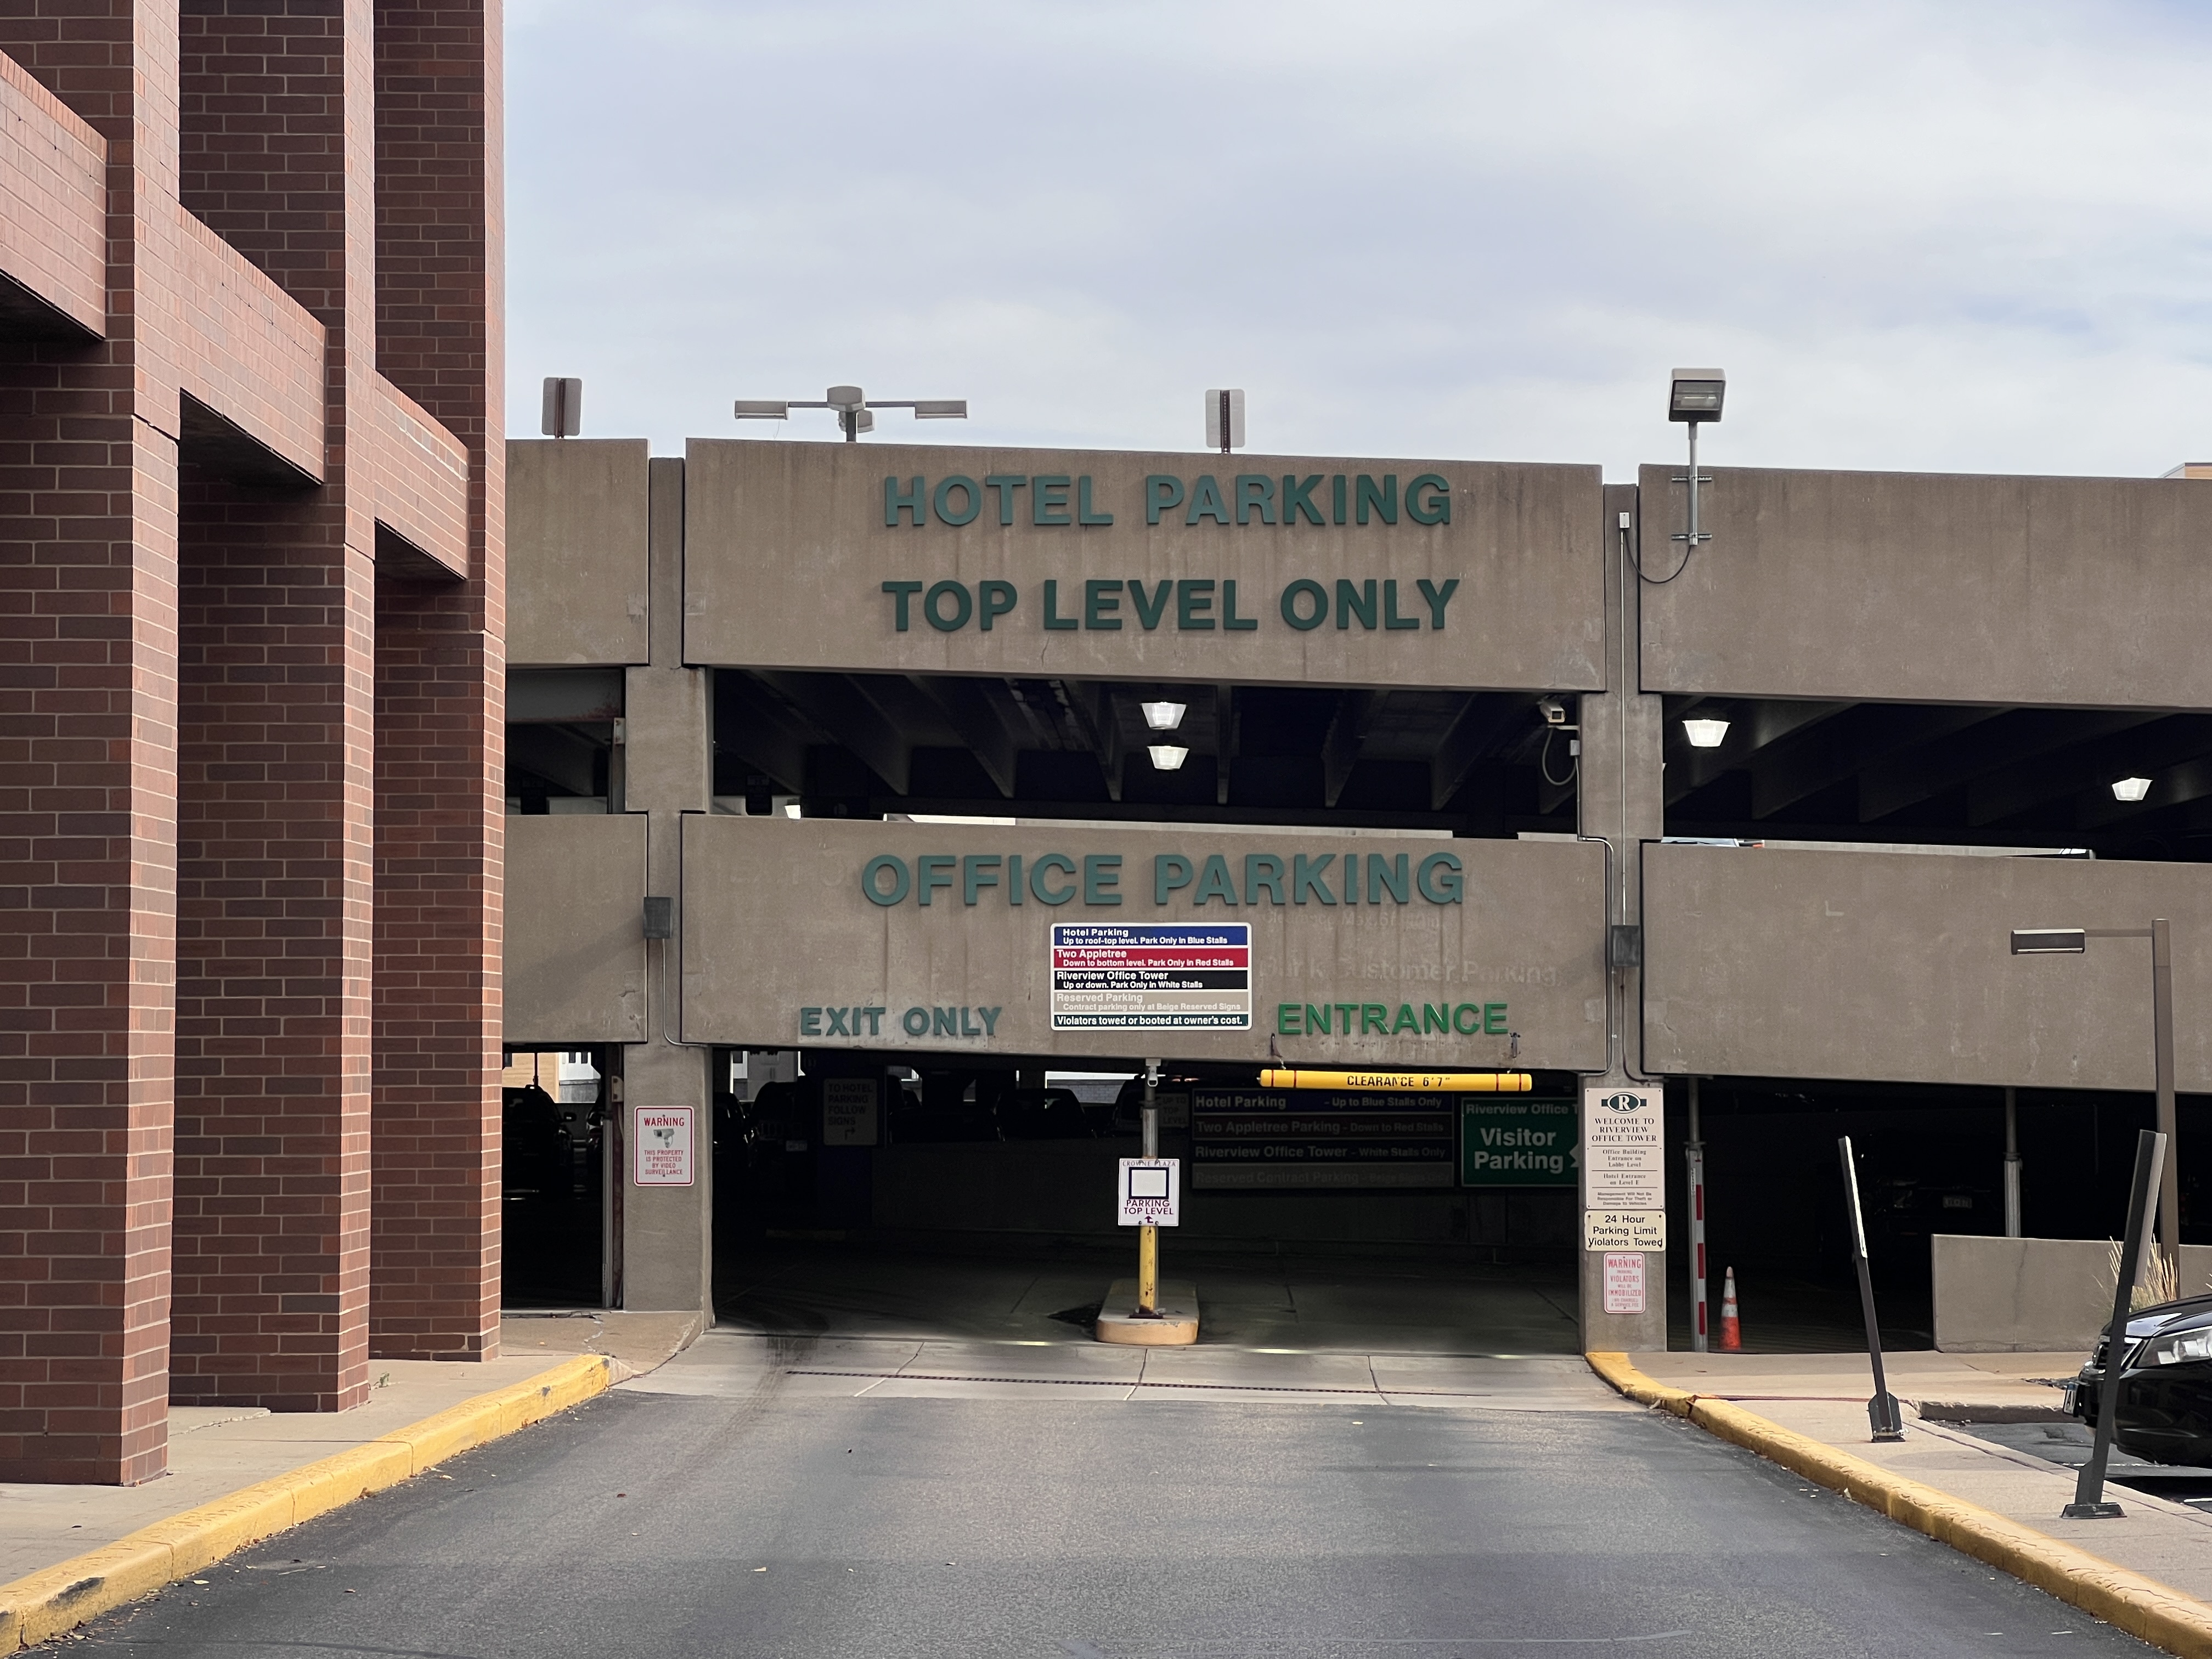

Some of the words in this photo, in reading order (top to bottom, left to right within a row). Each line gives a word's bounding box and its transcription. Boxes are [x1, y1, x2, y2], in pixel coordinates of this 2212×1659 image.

[886, 476, 1113, 525] HOTEL
[1148, 474, 1450, 525] PARKING
[883, 580, 1017, 631] TOP
[1045, 579, 1257, 630] LEVEL
[1282, 579, 1457, 630] ONLY
[865, 854, 1121, 905] OFFICE
[1157, 852, 1462, 902] PARKING
[1091, 929, 1128, 938] Parking
[1063, 937, 1074, 945] Up
[1085, 937, 1117, 945] roof-top
[1159, 937, 1177, 945] Only
[1080, 950, 1127, 960] Appletree
[1167, 960, 1185, 968] Only
[1057, 972, 1104, 980] Riverview
[1107, 972, 1136, 980] Office
[1139, 972, 1169, 980] Tower
[1063, 981, 1074, 990] Up
[1130, 981, 1148, 990] Only
[1057, 994, 1103, 1002] Reserved
[1106, 994, 1143, 1003] Parking
[1098, 1004, 1128, 1012] parking
[1129, 1003, 1145, 1012] only
[1156, 1003, 1179, 1012] Beige
[1219, 1003, 1240, 1012] Signs
[800, 1007, 886, 1036] EXIT
[903, 1007, 1002, 1036] ONLY
[1057, 1016, 1097, 1025] Violators
[1099, 1016, 1126, 1025] towed
[1139, 1016, 1171, 1025] booted
[1184, 1015, 1218, 1024] owner's
[1220, 1016, 1242, 1024] cost.
[1277, 1002, 1508, 1036] ENTRANCE
[1347, 1076, 1414, 1088] CLEARANCE
[1195, 1096, 1231, 1107] Hotel
[1235, 1096, 1286, 1109] Parking
[1332, 1097, 1347, 1108] Up
[1349, 1097, 1359, 1107] to
[1362, 1097, 1385, 1107] Blue
[1387, 1097, 1415, 1107] Stalls
[1418, 1097, 1442, 1109] Only
[1618, 1096, 1630, 1110] R
[1466, 1104, 1527, 1115] Riverview
[1531, 1104, 1567, 1114] Office
[644, 1118, 684, 1126] WARNING
[1198, 1121, 1222, 1132] Two
[1226, 1121, 1288, 1135] Appletree
[1291, 1121, 1340, 1135] Parking
[1381, 1124, 1392, 1132] to
[1481, 1127, 1556, 1147] Visitor
[1195, 1146, 1260, 1158] Riverview
[1263, 1146, 1305, 1158] Office
[1309, 1146, 1347, 1157] Tower
[1359, 1147, 1389, 1157] White
[1391, 1147, 1419, 1157] Stalls
[1422, 1147, 1446, 1159] Only
[1474, 1152, 1564, 1174] Parking
[1605, 1215, 1617, 1223] 24
[1622, 1215, 1645, 1223] Hour
[1593, 1226, 1629, 1236] Parking
[1634, 1226, 1657, 1234] Limit
[1588, 1238, 1628, 1248] Violators
[1634, 1238, 1663, 1246] Towed
[1609, 1259, 1641, 1268] WARNING
